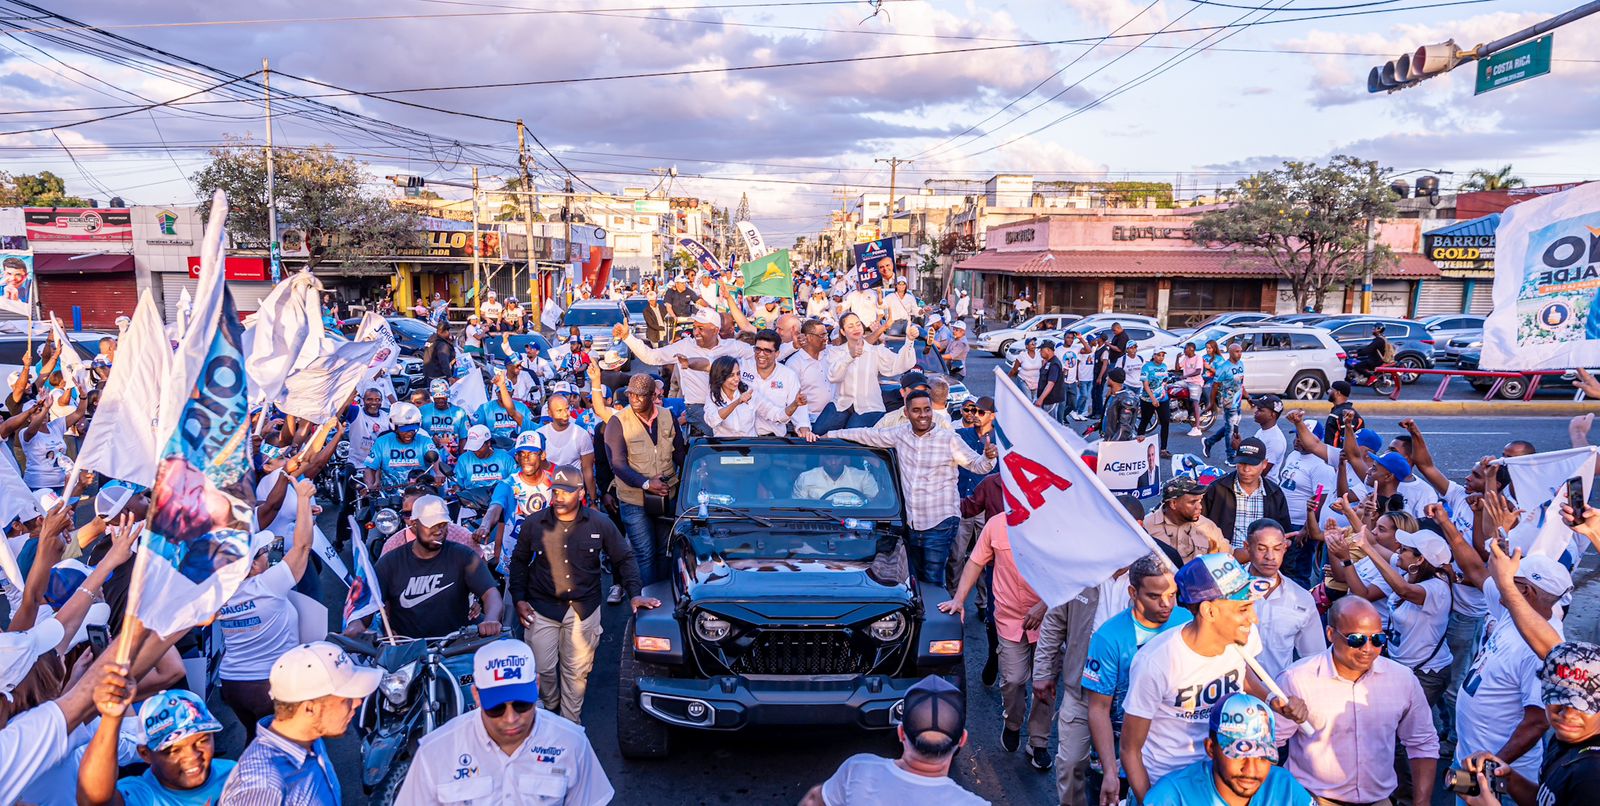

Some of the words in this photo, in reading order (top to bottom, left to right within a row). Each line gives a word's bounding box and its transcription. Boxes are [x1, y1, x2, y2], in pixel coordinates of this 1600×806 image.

[1493, 60, 1513, 76] COSTA
[1515, 54, 1531, 70] RICA
[1433, 248, 1480, 260] GOLD
[374, 324, 397, 347] JORGE
[1104, 461, 1147, 472] AGENTES
[405, 573, 443, 596] NIKE
[494, 667, 521, 681] L24
[1174, 668, 1239, 707] FIOR
